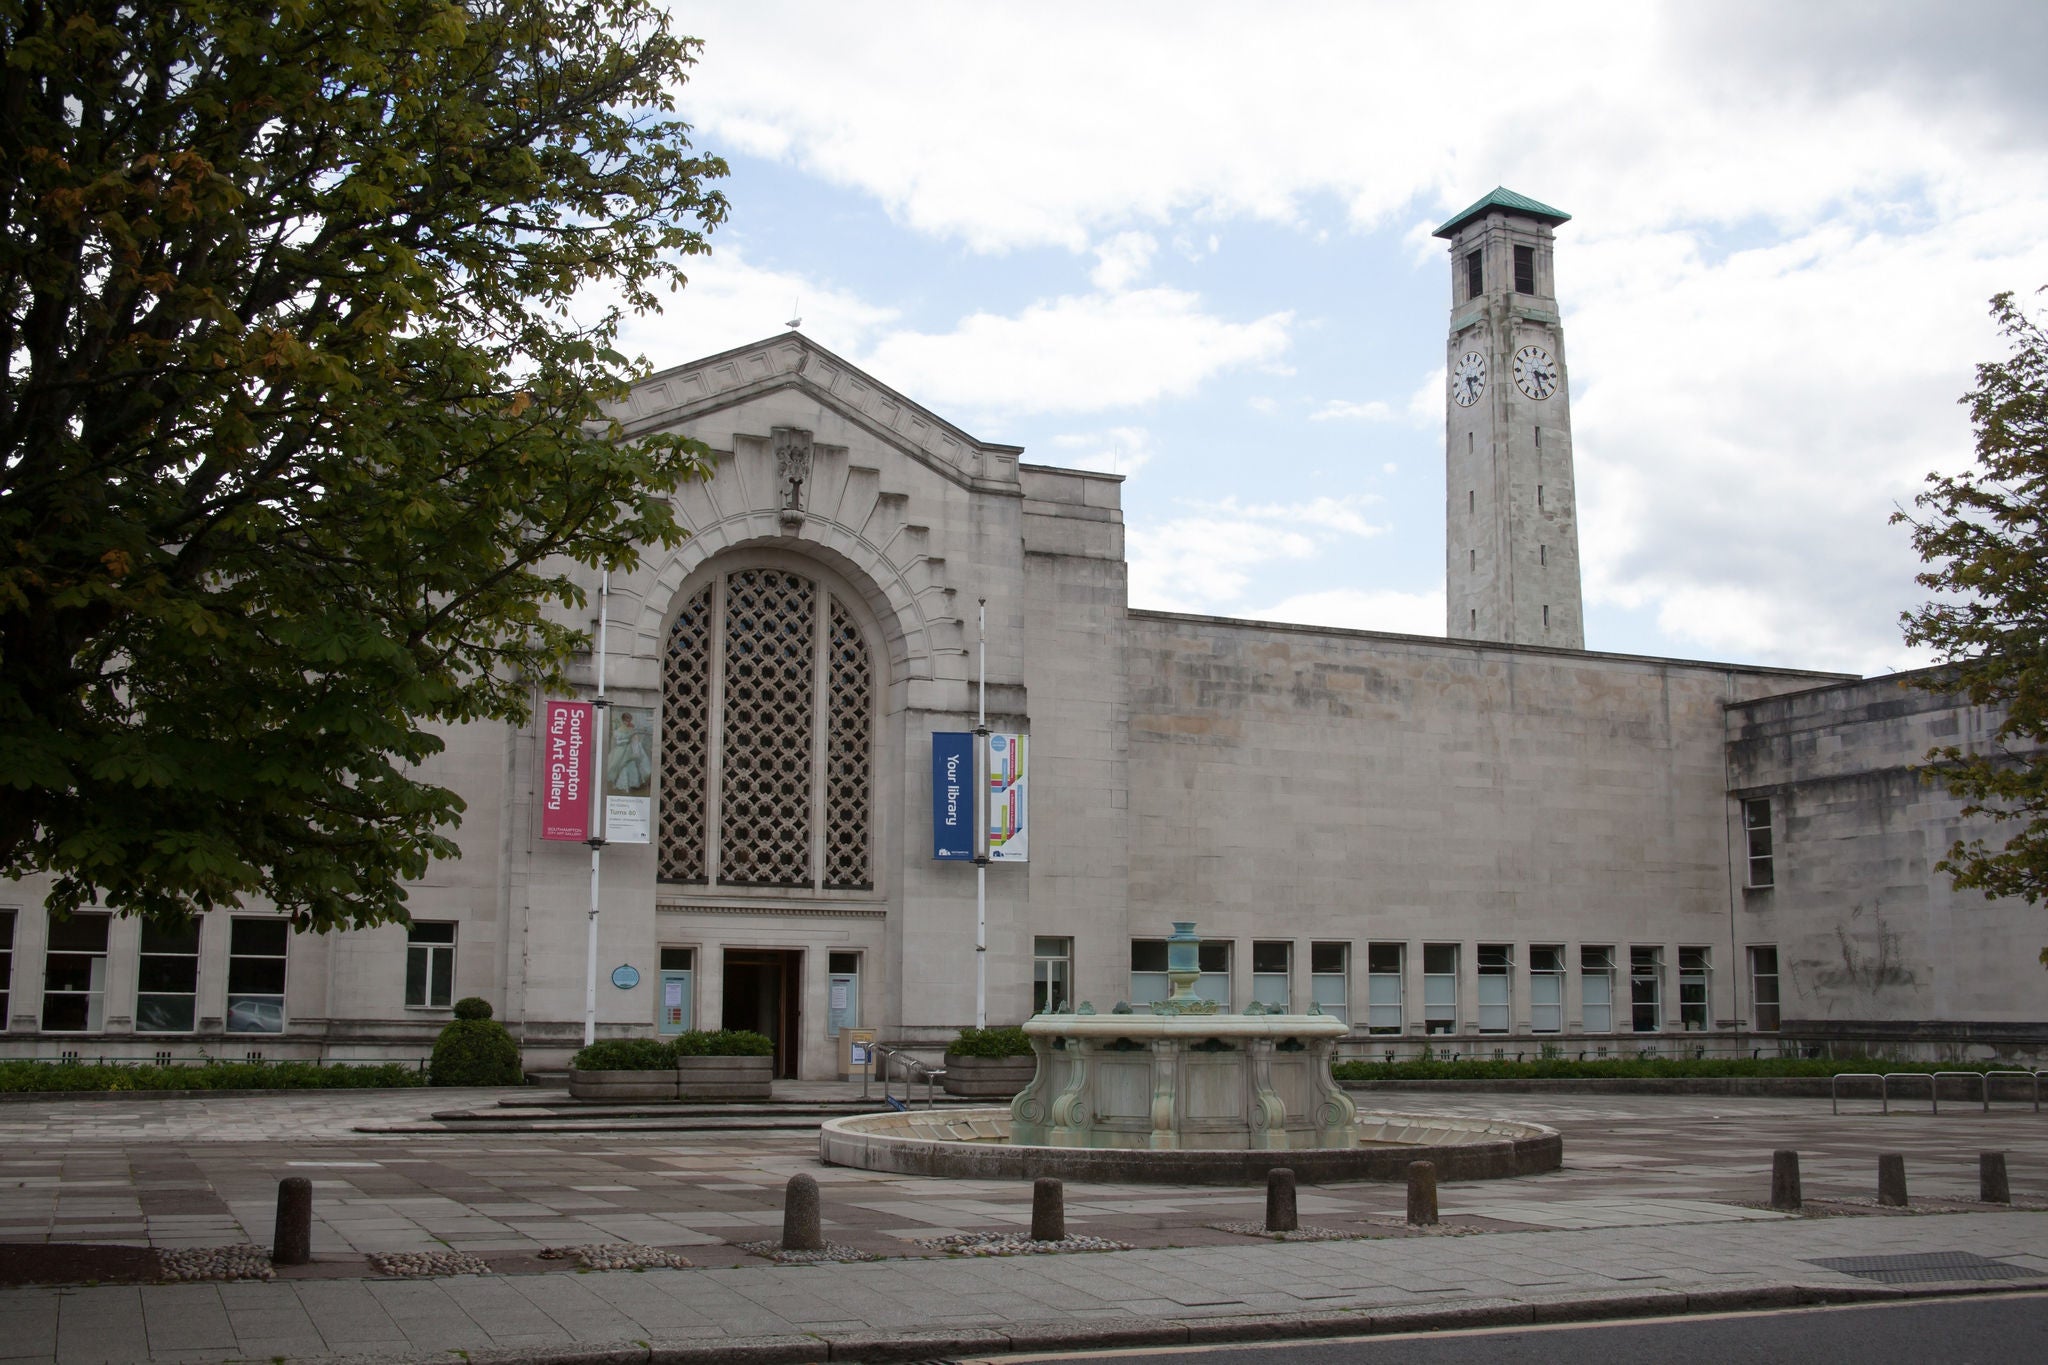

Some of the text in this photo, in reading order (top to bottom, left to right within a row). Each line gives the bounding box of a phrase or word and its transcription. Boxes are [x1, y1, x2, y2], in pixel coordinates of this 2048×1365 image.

[548, 708, 568, 810] City Art Gallery
[566, 709, 584, 801] Southampton
[946, 754, 960, 826] Your library
